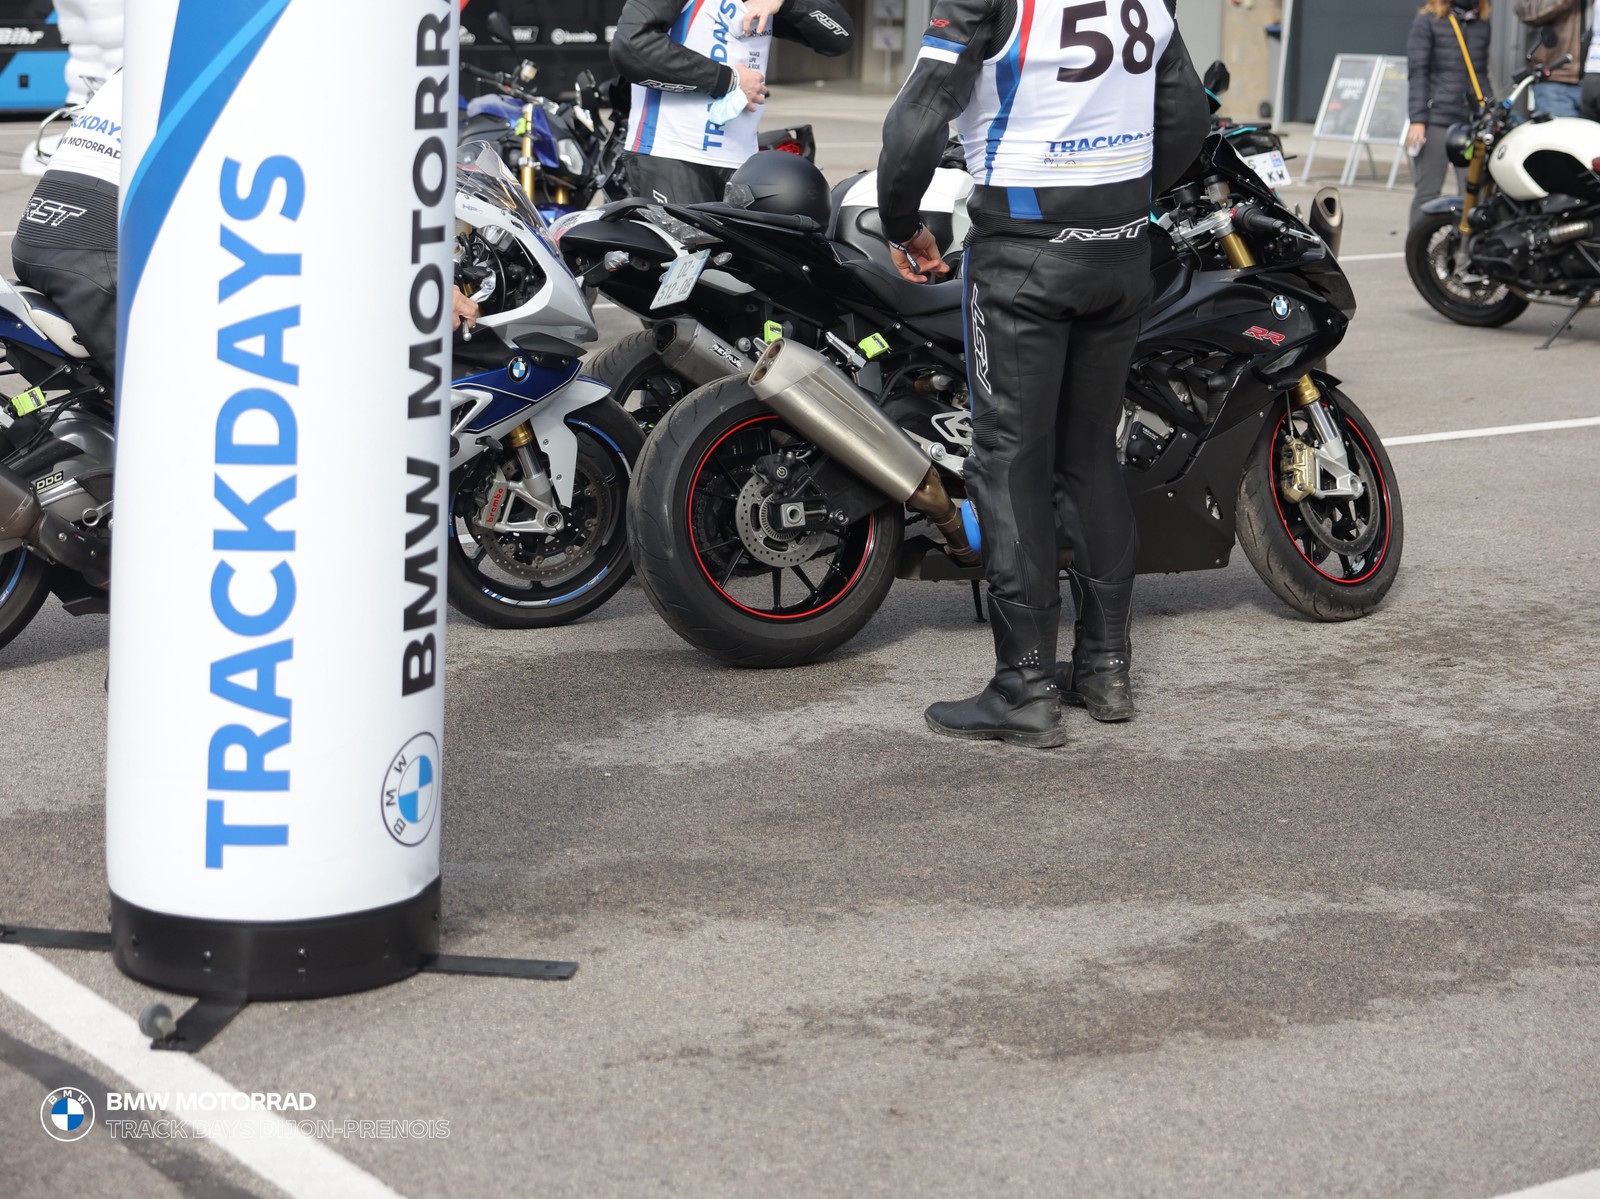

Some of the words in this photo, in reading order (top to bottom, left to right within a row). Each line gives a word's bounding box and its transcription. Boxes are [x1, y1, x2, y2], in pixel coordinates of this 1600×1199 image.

[808, 9, 849, 38] RST
[1242, 325, 1286, 347] RR
[711, 343, 742, 369] REMUS
[36, 472, 63, 490] DDC
[205, 155, 305, 869] TRACKDAYS
[487, 487, 504, 524] brembo
[401, 457, 440, 697] BMW
